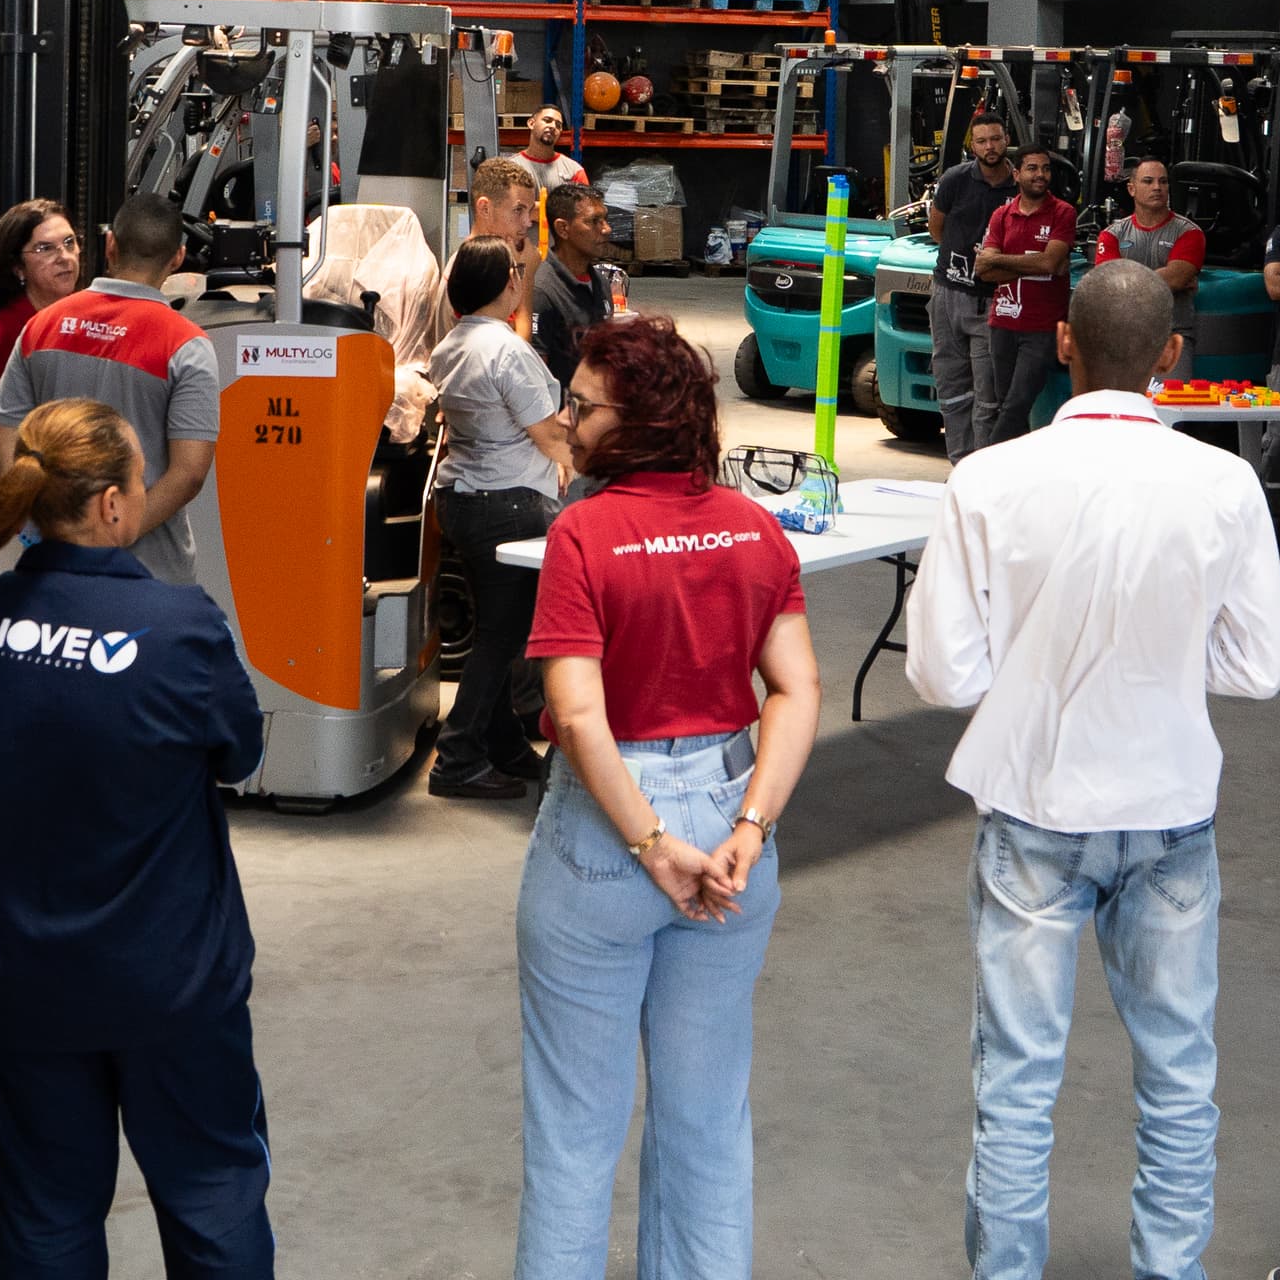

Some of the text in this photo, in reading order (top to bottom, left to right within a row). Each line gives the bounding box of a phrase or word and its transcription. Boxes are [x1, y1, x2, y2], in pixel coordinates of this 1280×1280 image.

[80, 319, 128, 338] MULTYLOG
[265, 347, 333, 359] MULTYLOG
[266, 396, 300, 417] ML
[255, 423, 303, 445] 270
